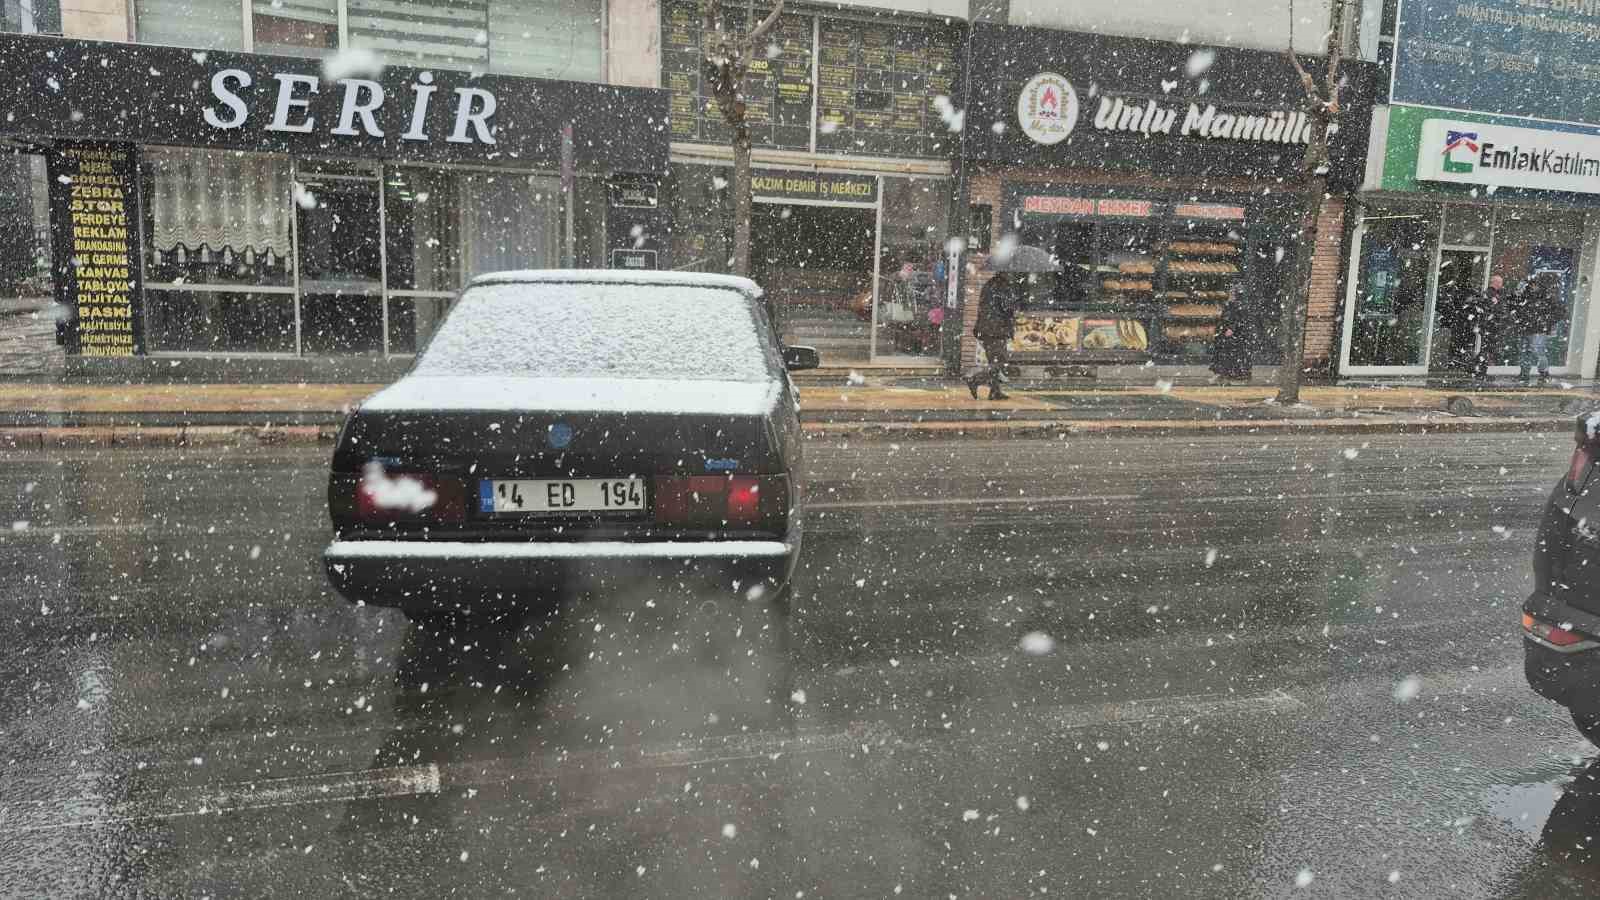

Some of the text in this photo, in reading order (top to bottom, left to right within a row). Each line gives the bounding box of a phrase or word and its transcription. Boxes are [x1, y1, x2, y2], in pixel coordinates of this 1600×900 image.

[202, 68, 497, 145] SERİR
[1094, 97, 1177, 134] Unlu
[752, 177, 783, 190] KAZIM
[786, 177, 817, 192] DEMİR
[71, 185, 123, 198] ZEBRA
[71, 200, 124, 212] STOR
[1024, 196, 1151, 217] MEYDAN EKMEK
[72, 213, 126, 225] PERDEYE
[73, 226, 127, 238] REKLAM
[93, 254, 128, 265] GERME
[76, 266, 129, 278] KANVAS
[78, 279, 129, 291] TABLOYA
[78, 292, 130, 304] DİJİTAL
[498, 481, 641, 507] 14 ED 194
